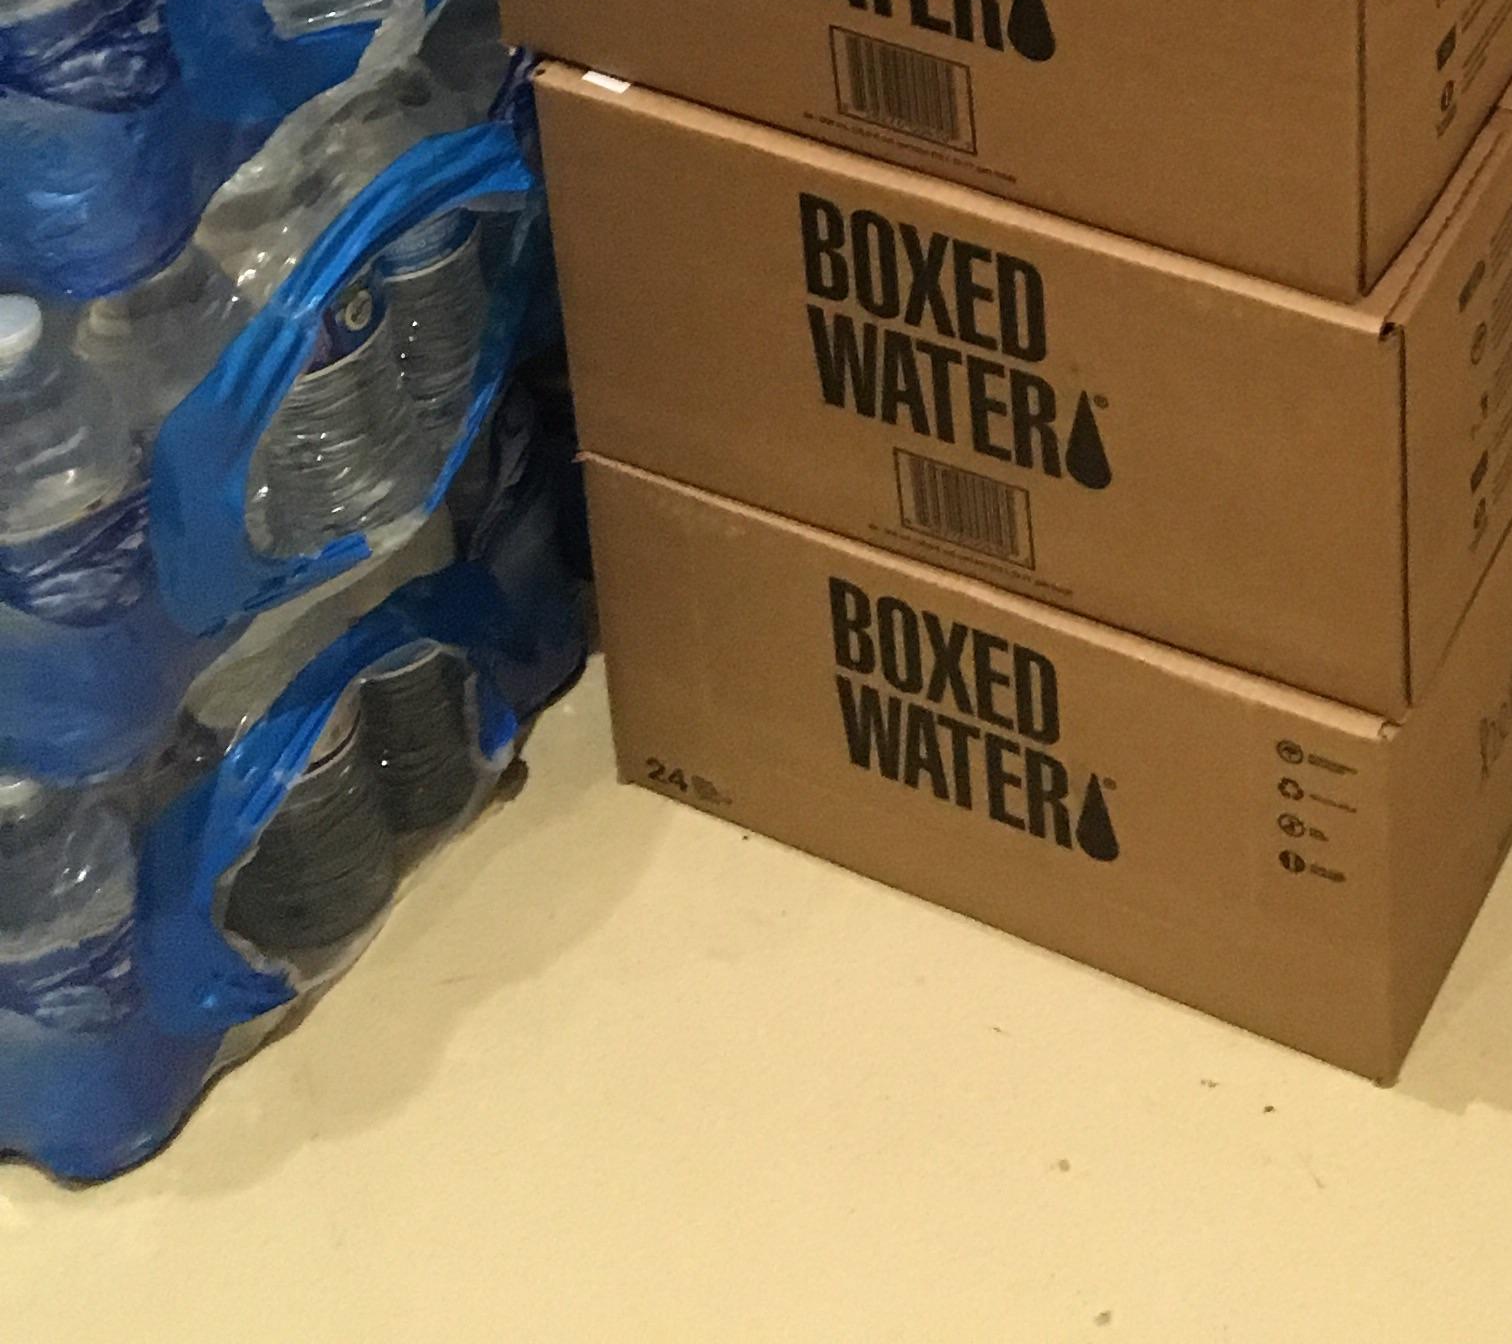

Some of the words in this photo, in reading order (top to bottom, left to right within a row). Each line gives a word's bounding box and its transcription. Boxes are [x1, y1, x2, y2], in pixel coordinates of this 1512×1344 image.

[799, 192, 1047, 363] BOXED
[806, 304, 1062, 478] WATER
[829, 576, 1060, 745] BOXED
[645, 757, 688, 793] 24
[835, 675, 1072, 849] WATER
